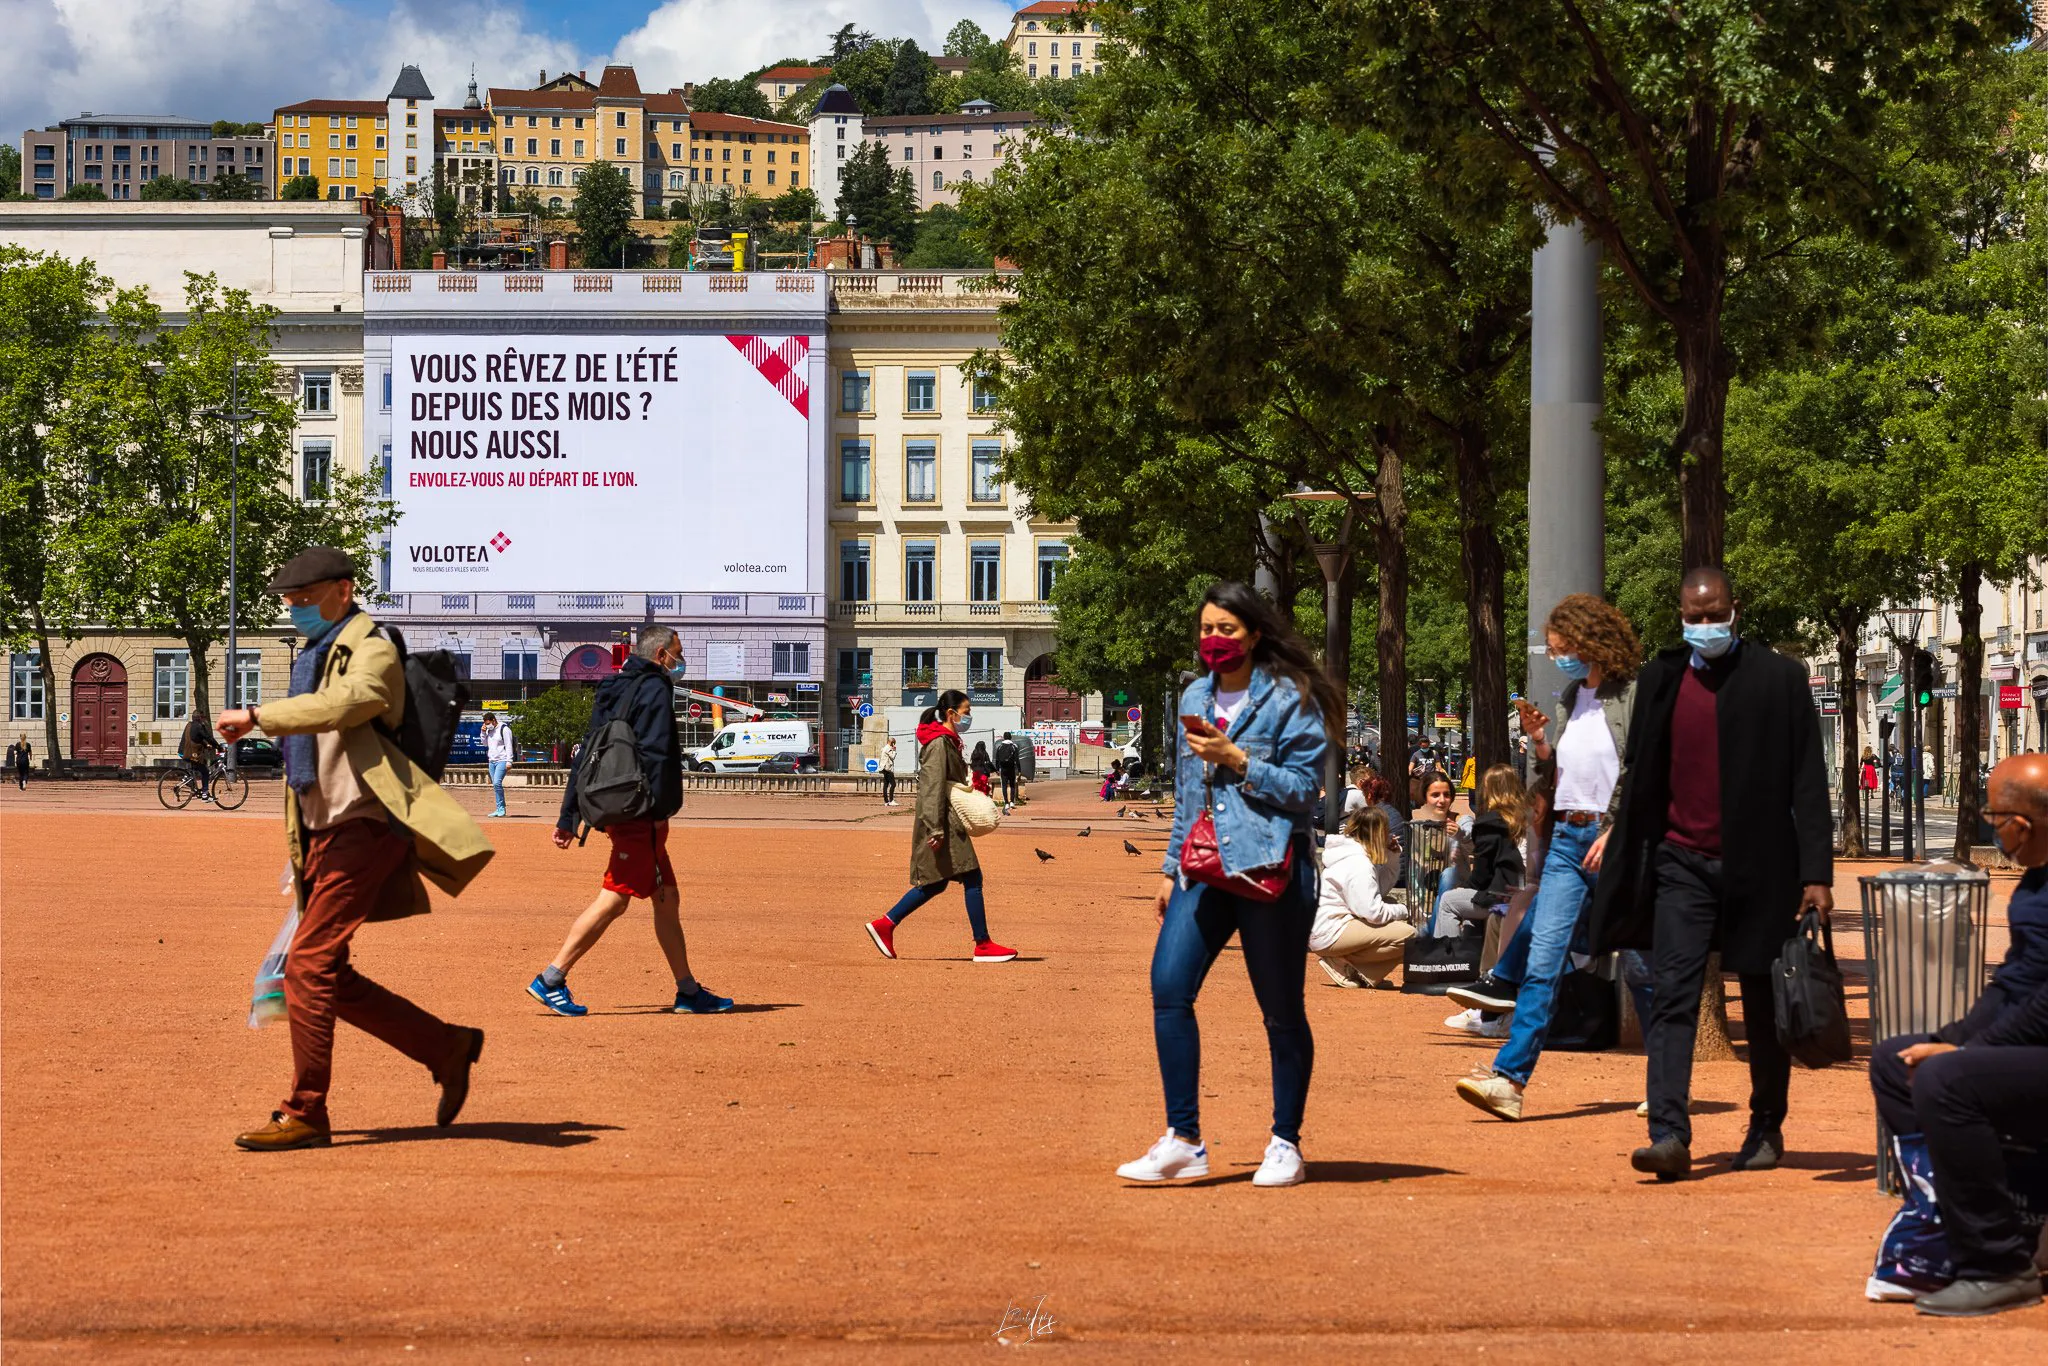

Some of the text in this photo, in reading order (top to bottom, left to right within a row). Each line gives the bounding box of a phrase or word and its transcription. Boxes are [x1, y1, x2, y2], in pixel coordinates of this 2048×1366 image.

[410, 346, 679, 383] VOUS RÊVEZ DE L'ÉTÉ
[411, 391, 653, 422] DEPUIS DES MOIS ?
[411, 429, 567, 460] NOUS AUSSI.
[409, 468, 638, 488] ENVOLEZ-VOUS AU DÉPART DE LYON.
[409, 545, 489, 563] VOLOTEA
[723, 562, 787, 574] volotea.com
[767, 733, 798, 743] TECMAT
[1057, 747, 1069, 757] Cie
